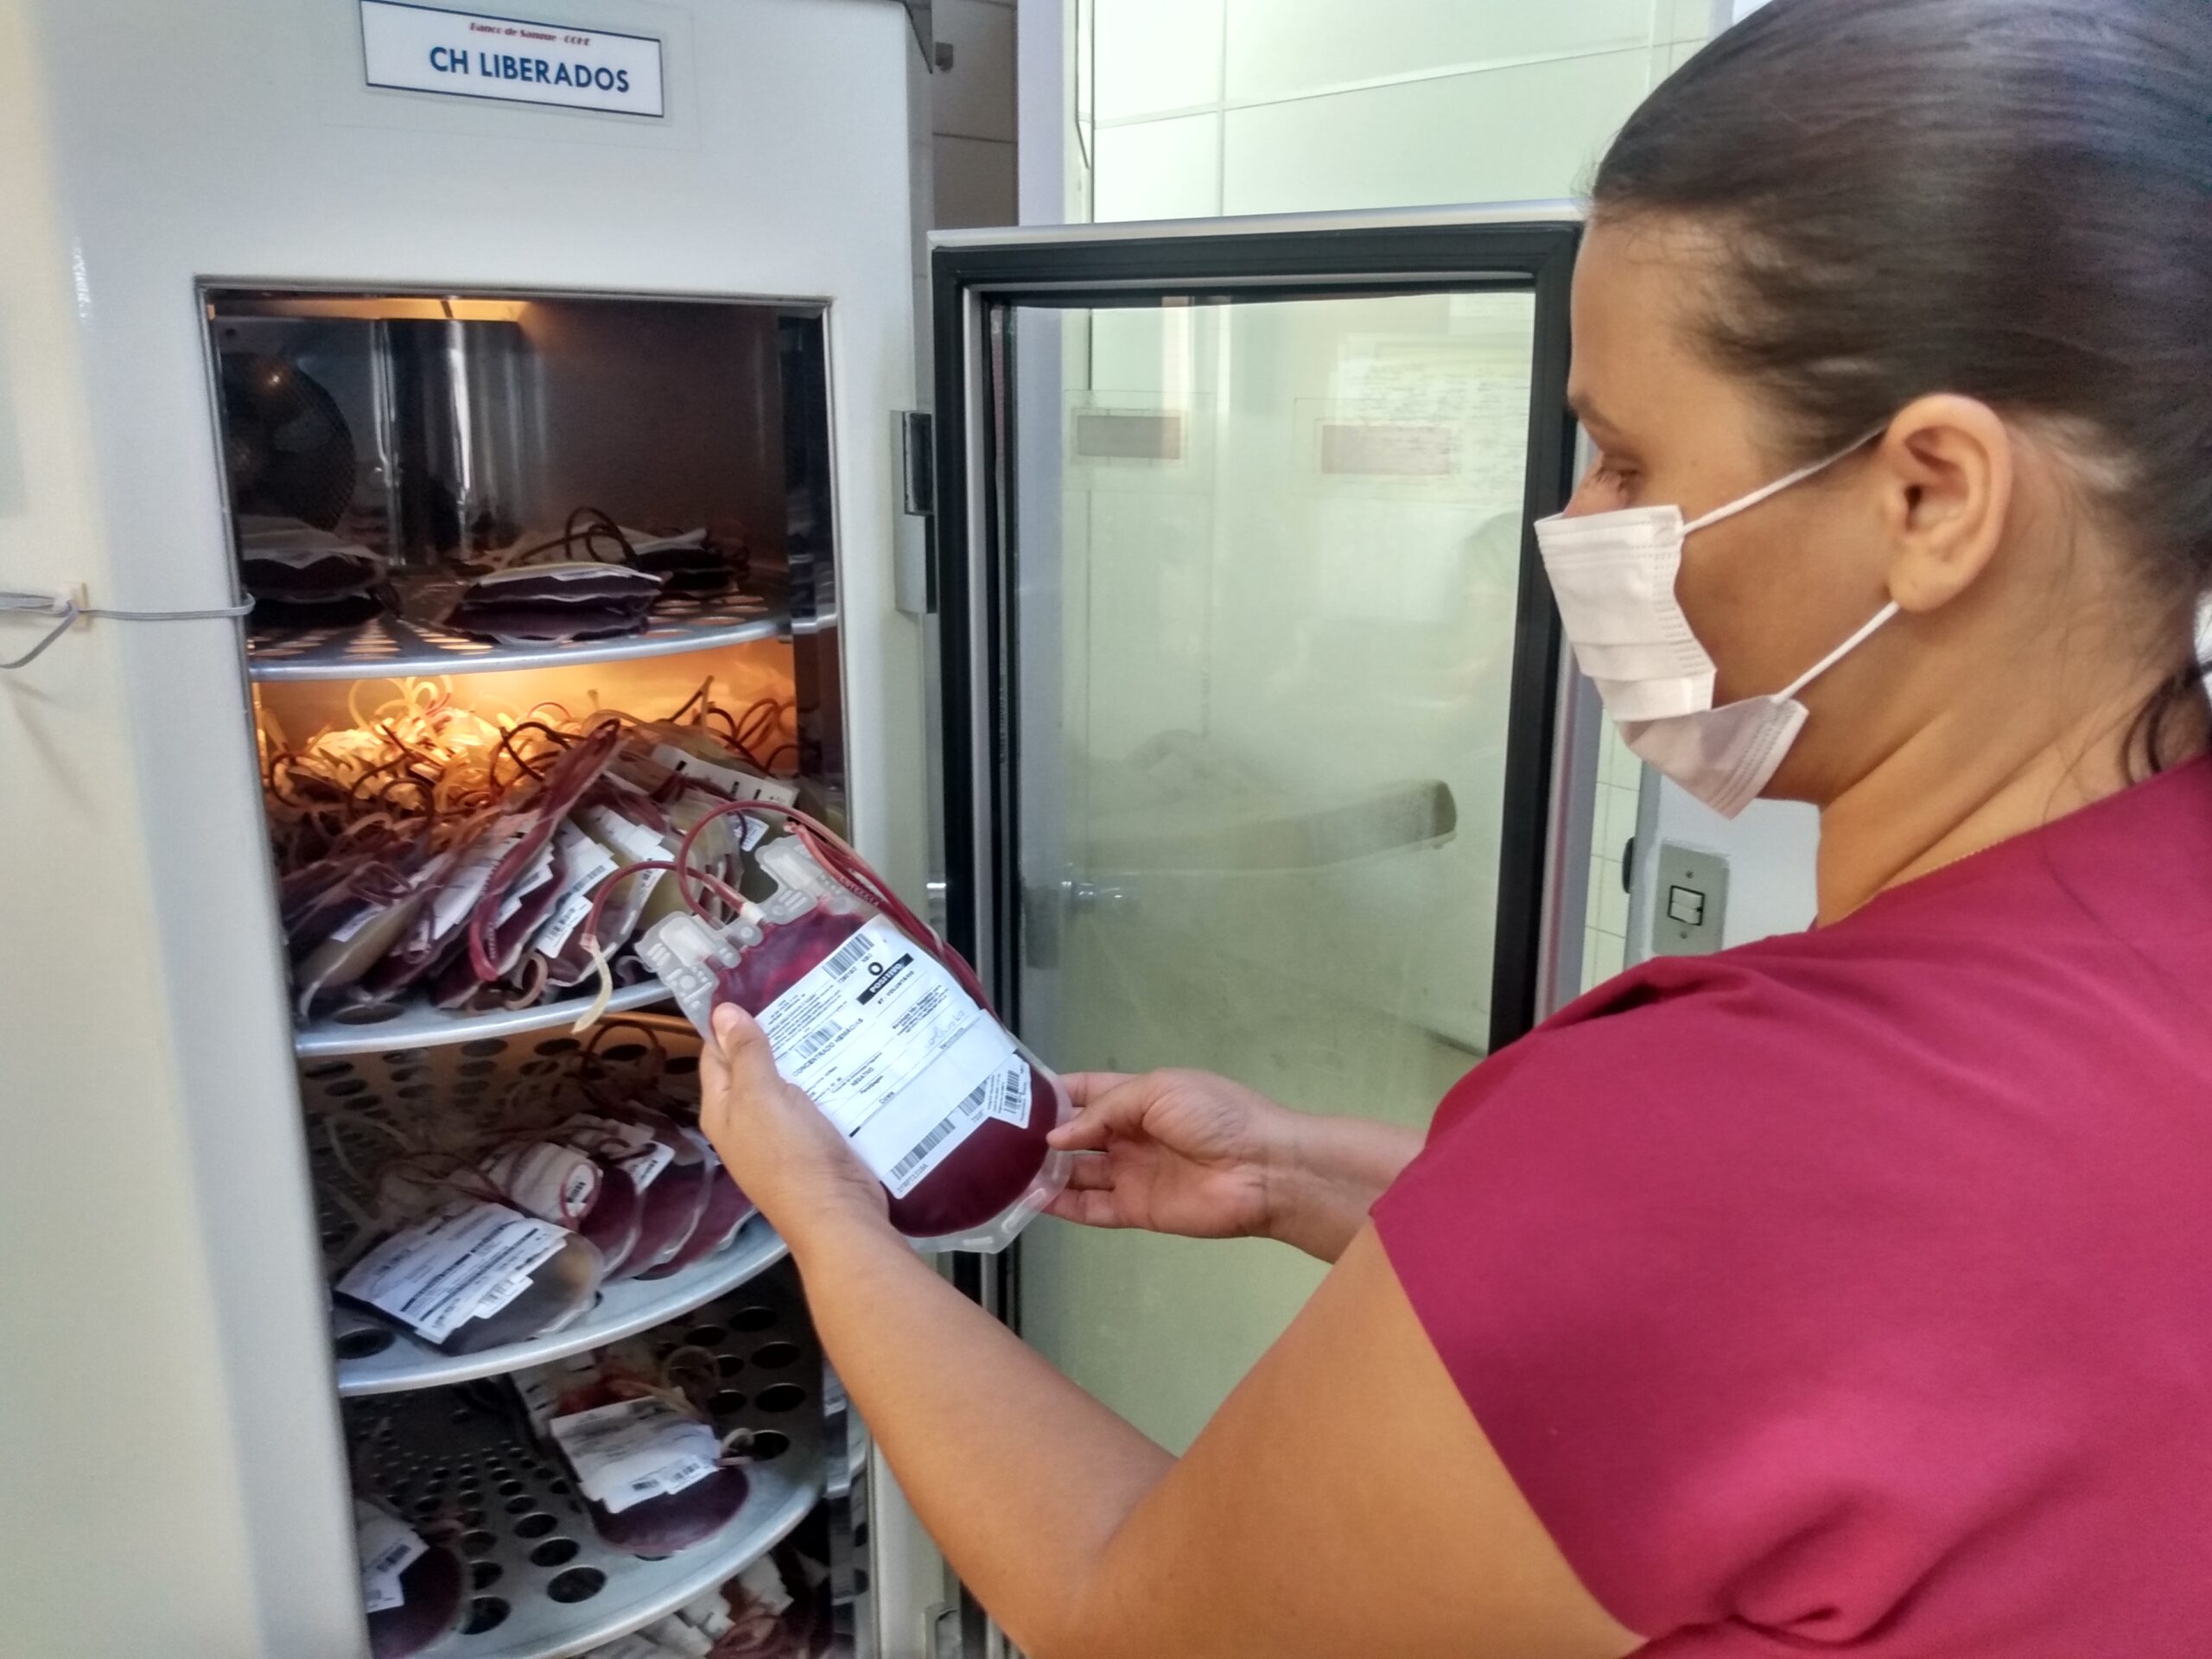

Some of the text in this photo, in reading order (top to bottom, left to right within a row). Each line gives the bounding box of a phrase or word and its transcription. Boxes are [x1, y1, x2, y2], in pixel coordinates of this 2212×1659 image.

[429, 47, 630, 92] CH LIBERADOS
[868, 962, 883, 976] O
[869, 963, 902, 993] POSITIVO
[791, 1042, 836, 1077] CONCENTRADO
[835, 1018, 863, 1043] HEMÁCIAS
[851, 1067, 874, 1086] NEGATIVO
